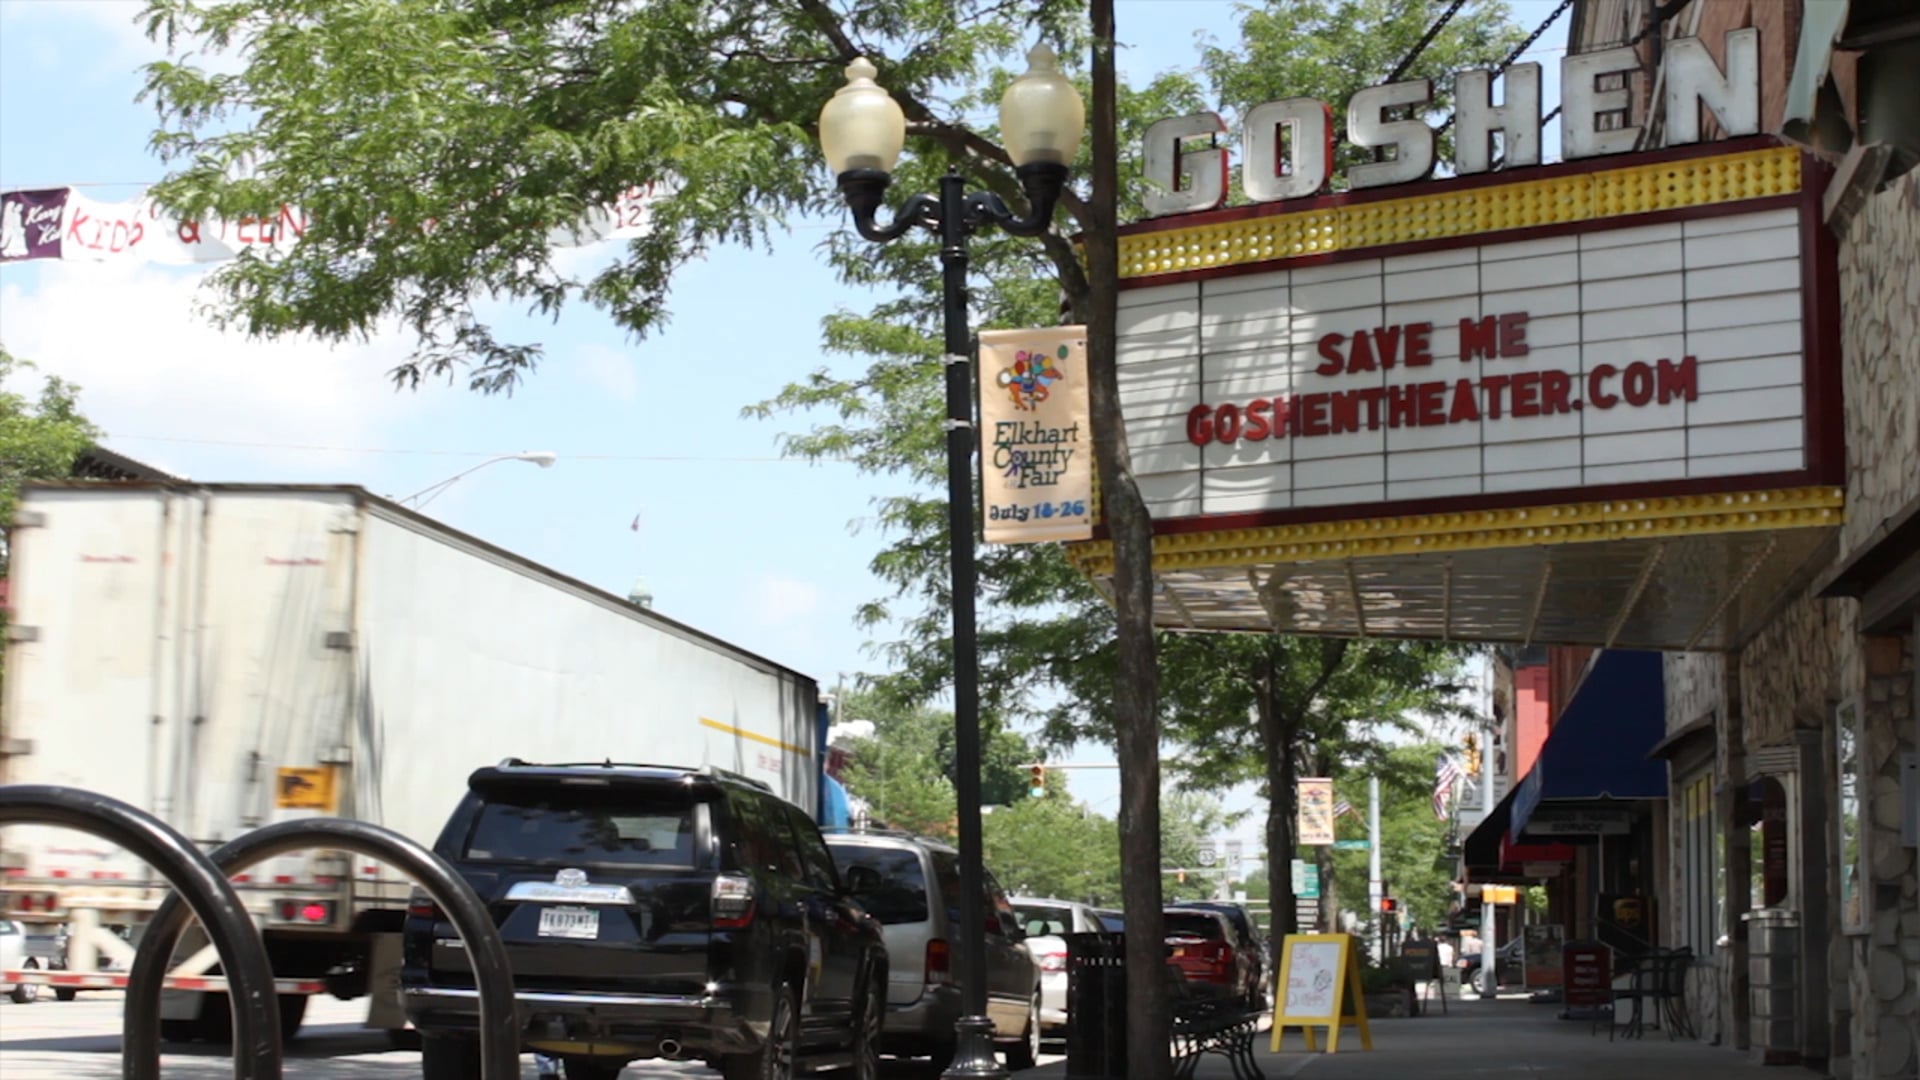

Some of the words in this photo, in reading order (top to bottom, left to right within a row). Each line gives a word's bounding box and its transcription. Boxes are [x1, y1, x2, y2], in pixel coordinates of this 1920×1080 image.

[1143, 27, 1761, 217] GOSHEN
[1315, 322, 1433, 377] SAVE
[1459, 312, 1529, 362] ME
[1186, 355, 1698, 446] GOSHENTHEATER.COM
[993, 420, 1079, 446] Elkhart
[993, 444, 1075, 475] County
[1017, 465, 1061, 488] Fair
[989, 504, 1030, 522] July
[1033, 500, 1085, 519] 18-26
